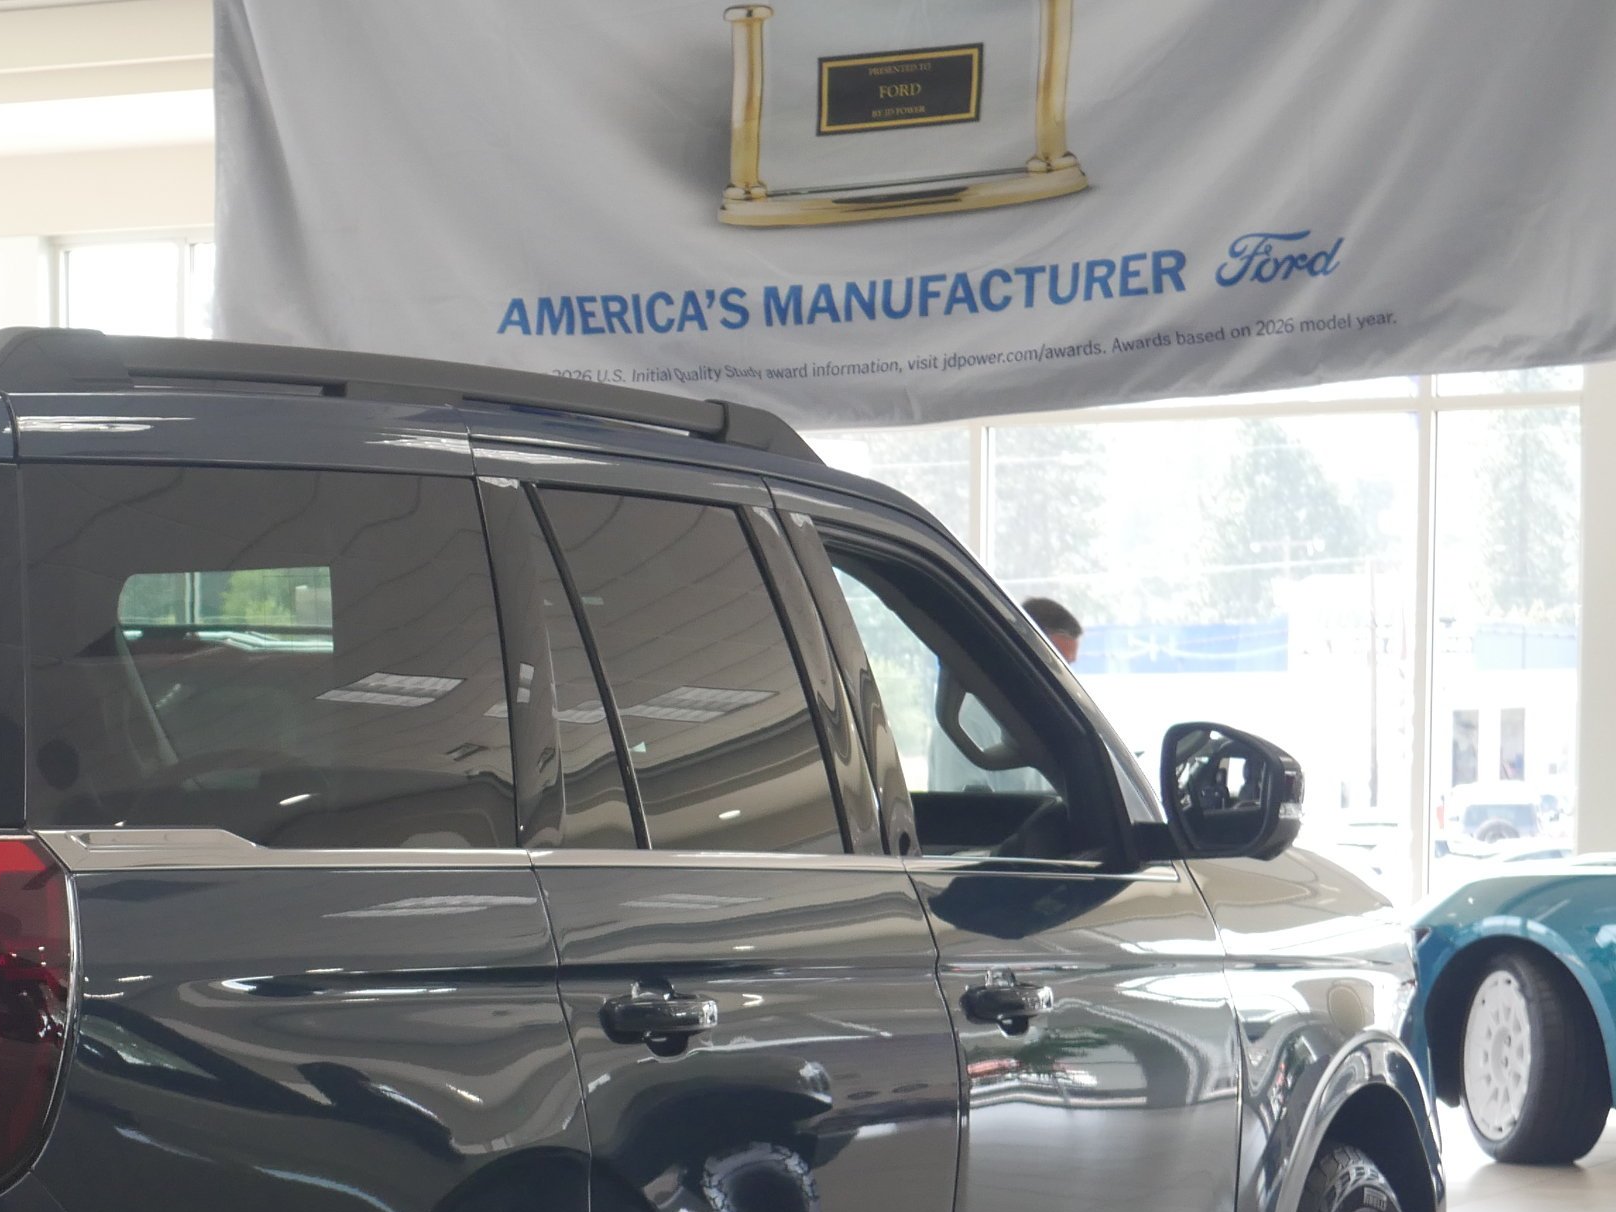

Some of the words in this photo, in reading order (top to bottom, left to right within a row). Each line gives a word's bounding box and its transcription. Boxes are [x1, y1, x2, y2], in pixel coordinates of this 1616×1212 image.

[879, 82, 921, 98] FORD
[896, 105, 926, 116] POWER
[496, 286, 750, 336] AMERICA'S
[763, 249, 1187, 327] MANUFACTURER
[1215, 230, 1345, 287] Ford
[597, 368, 626, 383] U.S.
[632, 367, 672, 382] Initial
[674, 365, 721, 383] Quality
[725, 364, 763, 380] Study
[766, 363, 808, 379] award
[812, 358, 903, 379] information,
[907, 354, 939, 372] visit
[941, 342, 1106, 371] jdpower.com/awards.
[1111, 332, 1172, 353] Awards
[1175, 327, 1226, 346] based
[1230, 324, 1252, 340] on
[1255, 317, 1295, 336] 2026
[1299, 312, 1352, 332] model
[1356, 311, 1398, 330] year.
